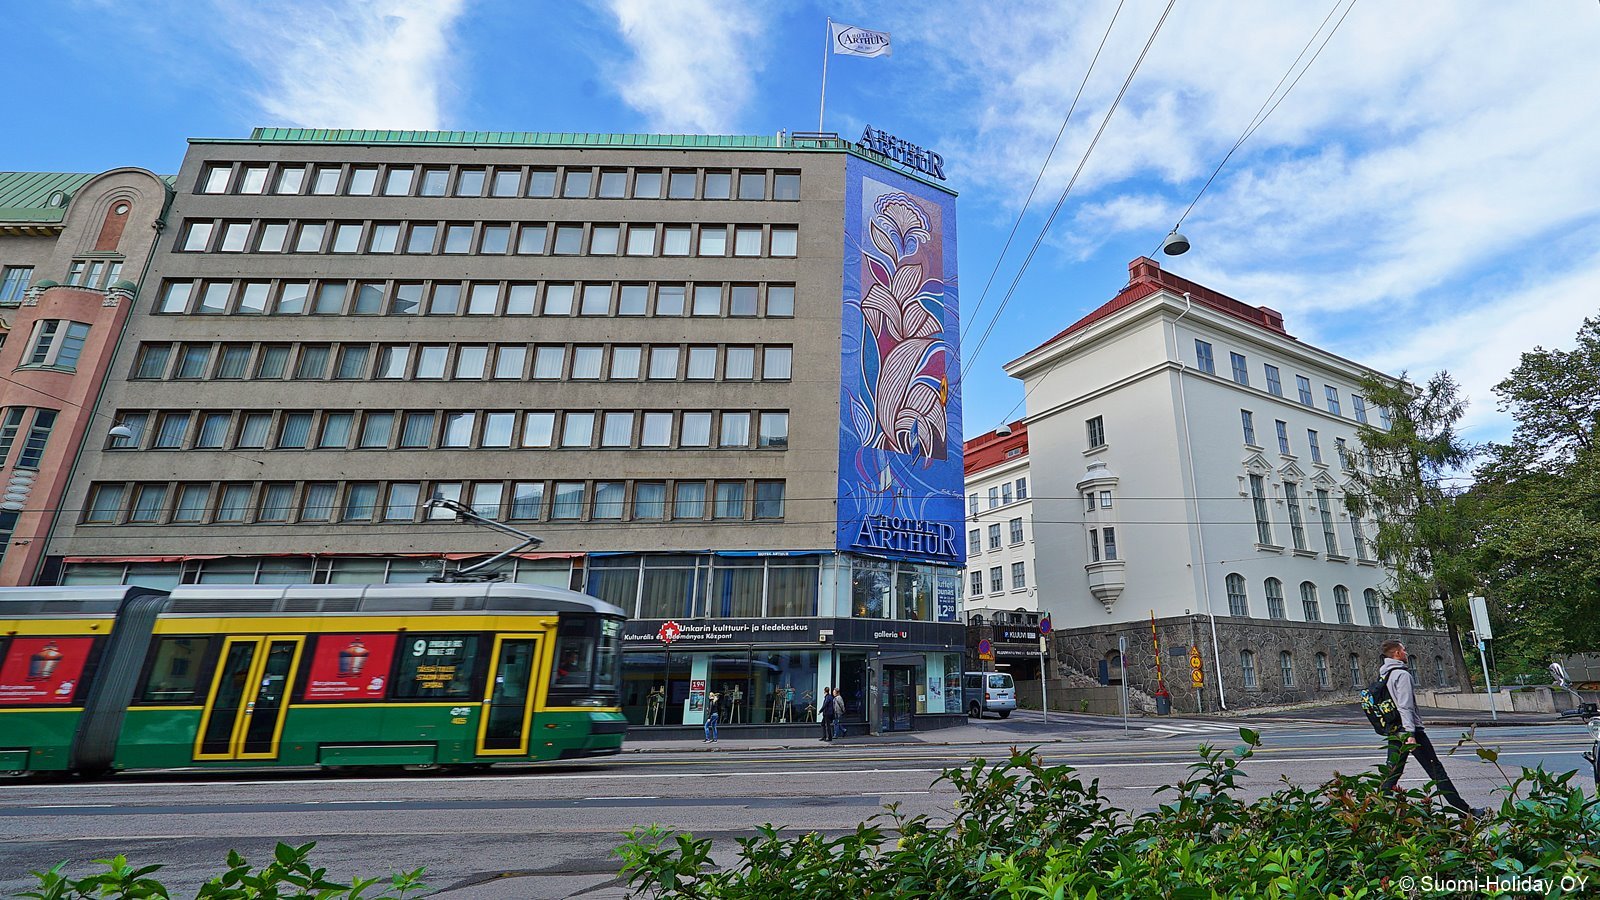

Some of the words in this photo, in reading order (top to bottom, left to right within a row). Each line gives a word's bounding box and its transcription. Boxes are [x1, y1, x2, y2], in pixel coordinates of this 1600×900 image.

[844, 33, 886, 45] ARTHUR
[877, 129, 923, 156] HOTEL
[855, 123, 947, 181] ARTHUR
[879, 514, 934, 534] HOTEL
[850, 513, 959, 557] ARTHUR
[679, 624, 711, 632] Unkarin
[712, 623, 750, 632] kulttuuri-
[751, 624, 760, 633] ja
[761, 623, 808, 632] tiedekeskus
[873, 630, 898, 639] galleria
[705, 633, 732, 641] Központ
[413, 640, 426, 656] 9
